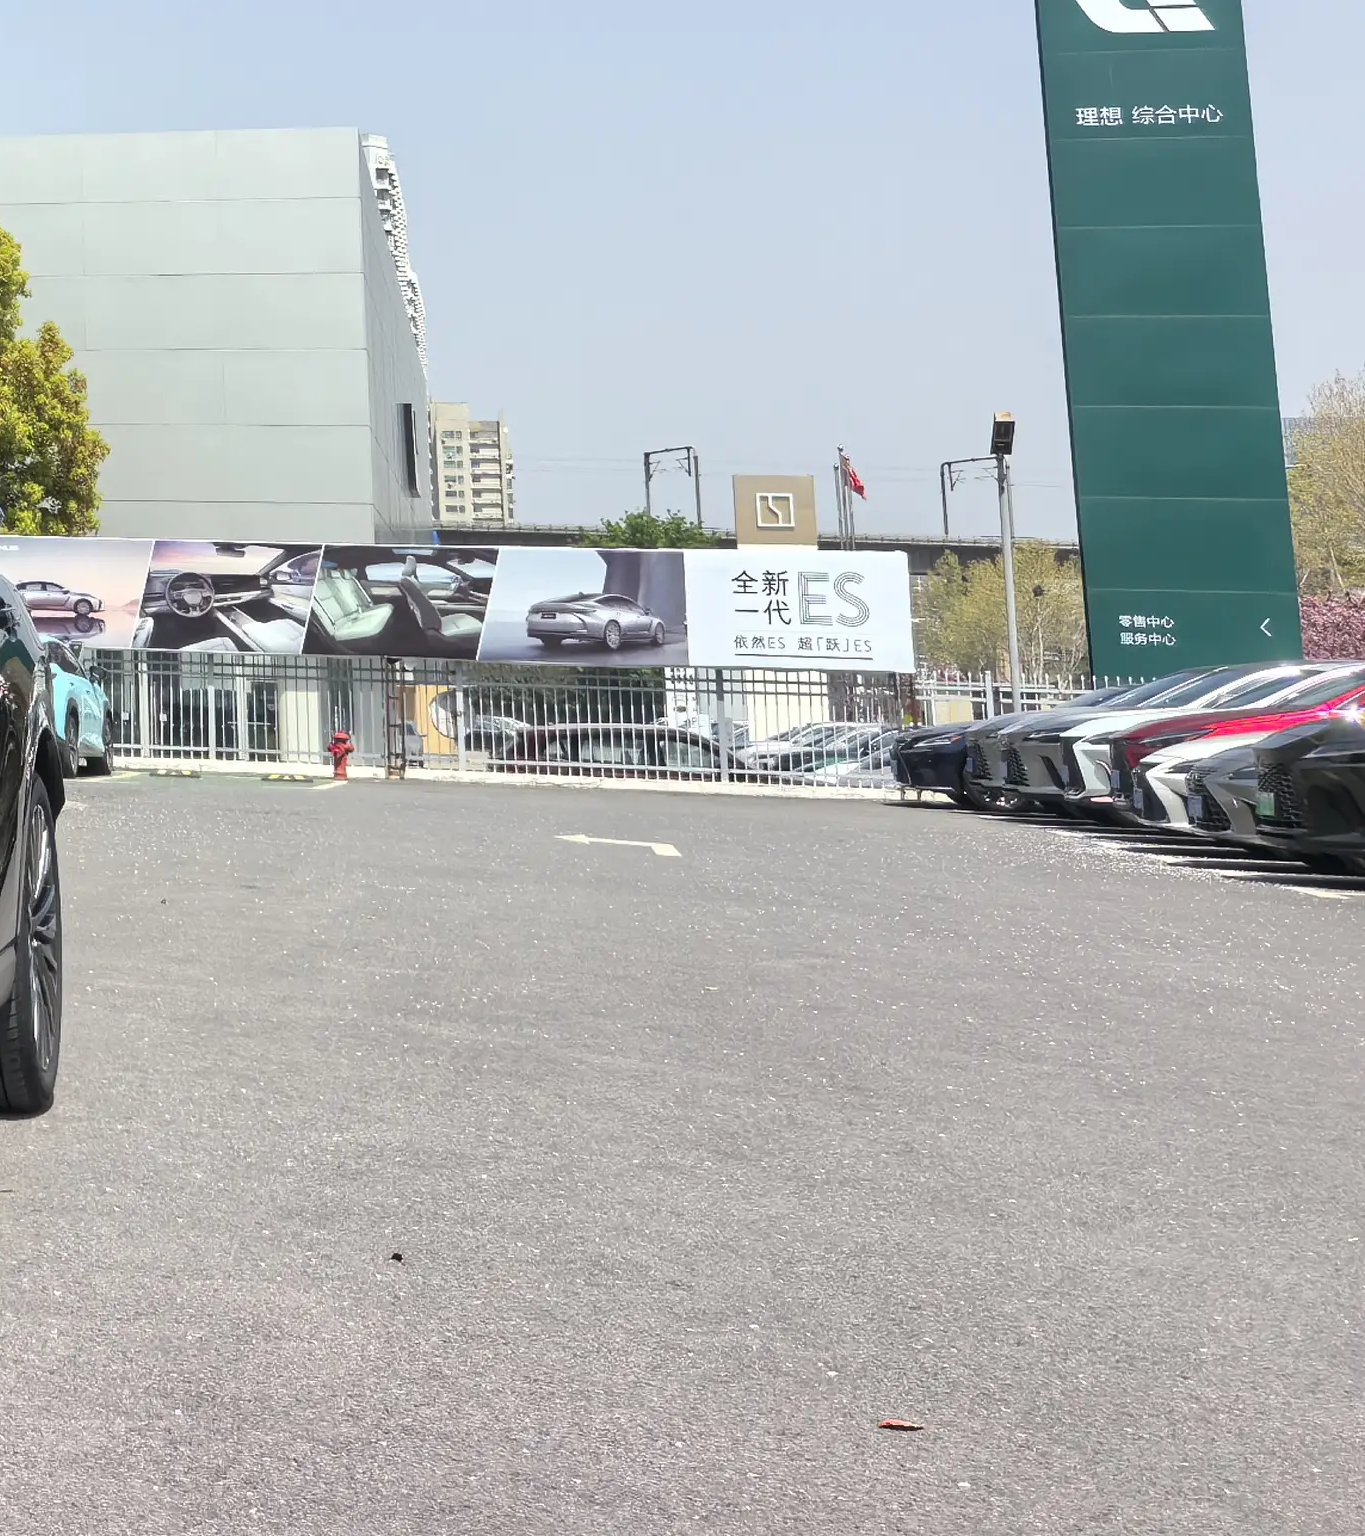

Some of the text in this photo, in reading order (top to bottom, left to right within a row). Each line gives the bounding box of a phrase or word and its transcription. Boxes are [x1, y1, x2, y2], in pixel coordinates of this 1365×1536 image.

[1075, 103, 1224, 127] 理想 综合中心
[731, 570, 789, 596] 全新
[797, 571, 870, 627] ES
[734, 599, 791, 625] 一代
[1118, 614, 1175, 629] 零售中心
[733, 635, 786, 649] 依然ES
[1120, 631, 1177, 646] 服务中心
